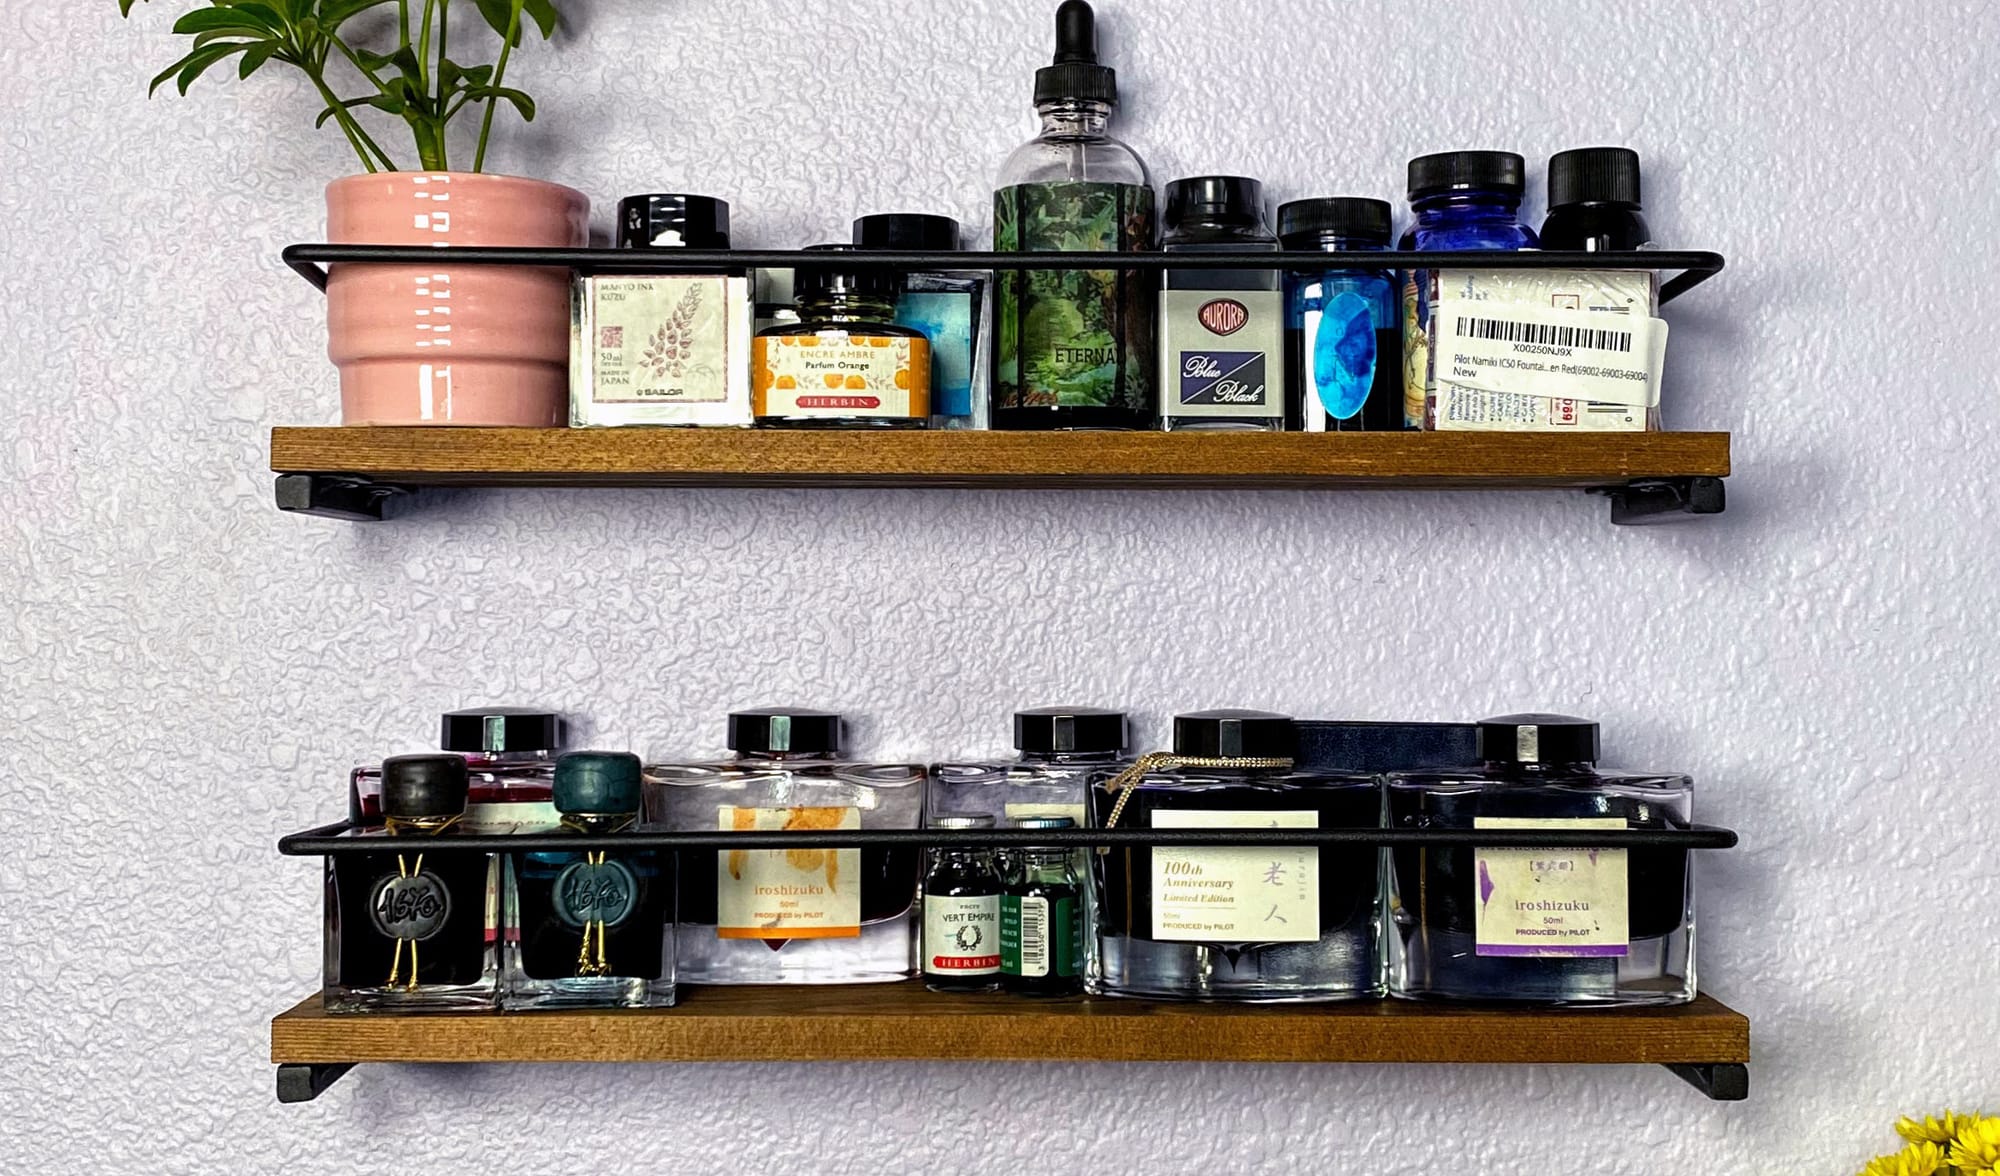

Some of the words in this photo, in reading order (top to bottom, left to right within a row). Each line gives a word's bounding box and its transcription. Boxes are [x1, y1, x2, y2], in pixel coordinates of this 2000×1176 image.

[601, 283, 636, 292] MANYO
[637, 283, 654, 292] INK
[600, 293, 626, 302] KUZU
[1203, 302, 1244, 332] AURORA
[800, 350, 835, 359] ENCRE
[840, 350, 876, 359] AMBRE
[1055, 347, 1117, 364] ETERNA
[1513, 343, 1573, 357] X00250NJ9X
[805, 361, 835, 370] Parfum
[838, 361, 870, 371] Orange
[1454, 354, 1471, 365] Pilot
[1472, 355, 1498, 367] Namiki
[1499, 358, 1516, 368] IC50
[1183, 355, 1222, 379] Blue
[1453, 366, 1477, 378] New
[600, 376, 630, 386] JAPAN
[644, 388, 684, 396] SAILOR
[1213, 379, 1264, 404] Black
[806, 398, 869, 407] HERBIN
[1163, 861, 1203, 875] 100th
[1163, 876, 1234, 890] Anniversary
[754, 884, 824, 896] iroshizuku
[1163, 894, 1200, 903] Limited
[1200, 894, 1235, 904] Edition
[1515, 899, 1590, 912] iroshizuku
[943, 913, 964, 922] VERT
[968, 913, 995, 922] EMPIRE
[1204, 924, 1212, 932] by
[942, 958, 996, 968] HERBIN
